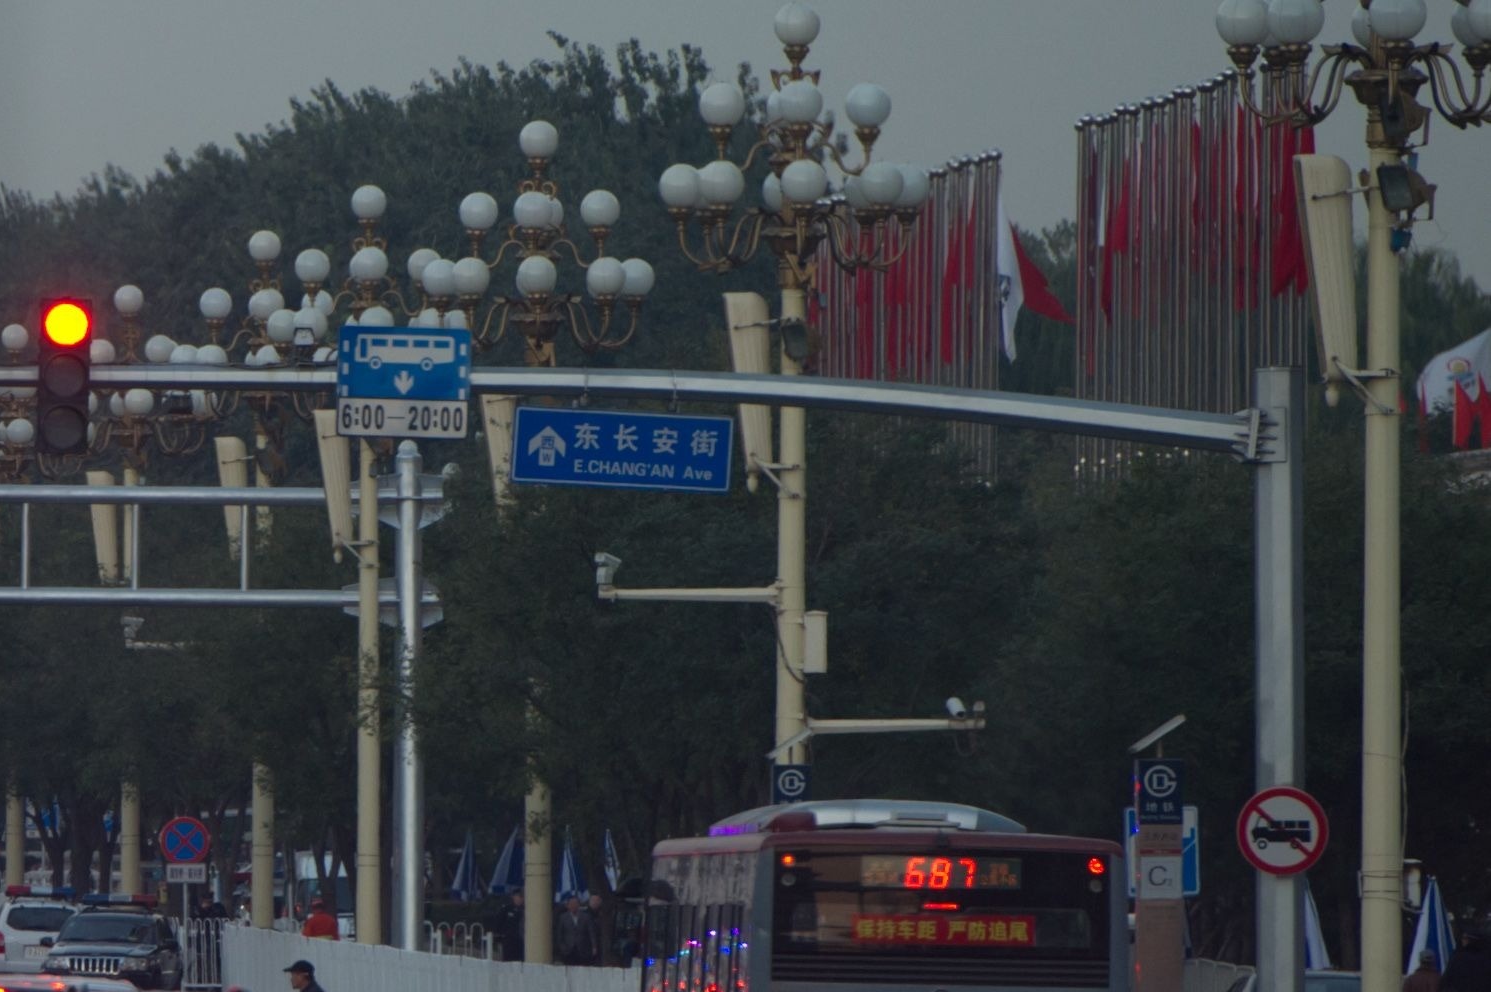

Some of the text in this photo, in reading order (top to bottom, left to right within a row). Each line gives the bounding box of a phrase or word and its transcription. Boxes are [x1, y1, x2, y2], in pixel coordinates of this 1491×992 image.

[574, 422, 719, 457] 东长安街
[573, 458, 713, 481] E.CHANG'AN Ave
[903, 856, 978, 889] 687
[857, 919, 1029, 942] 保持车距 严防追尾
